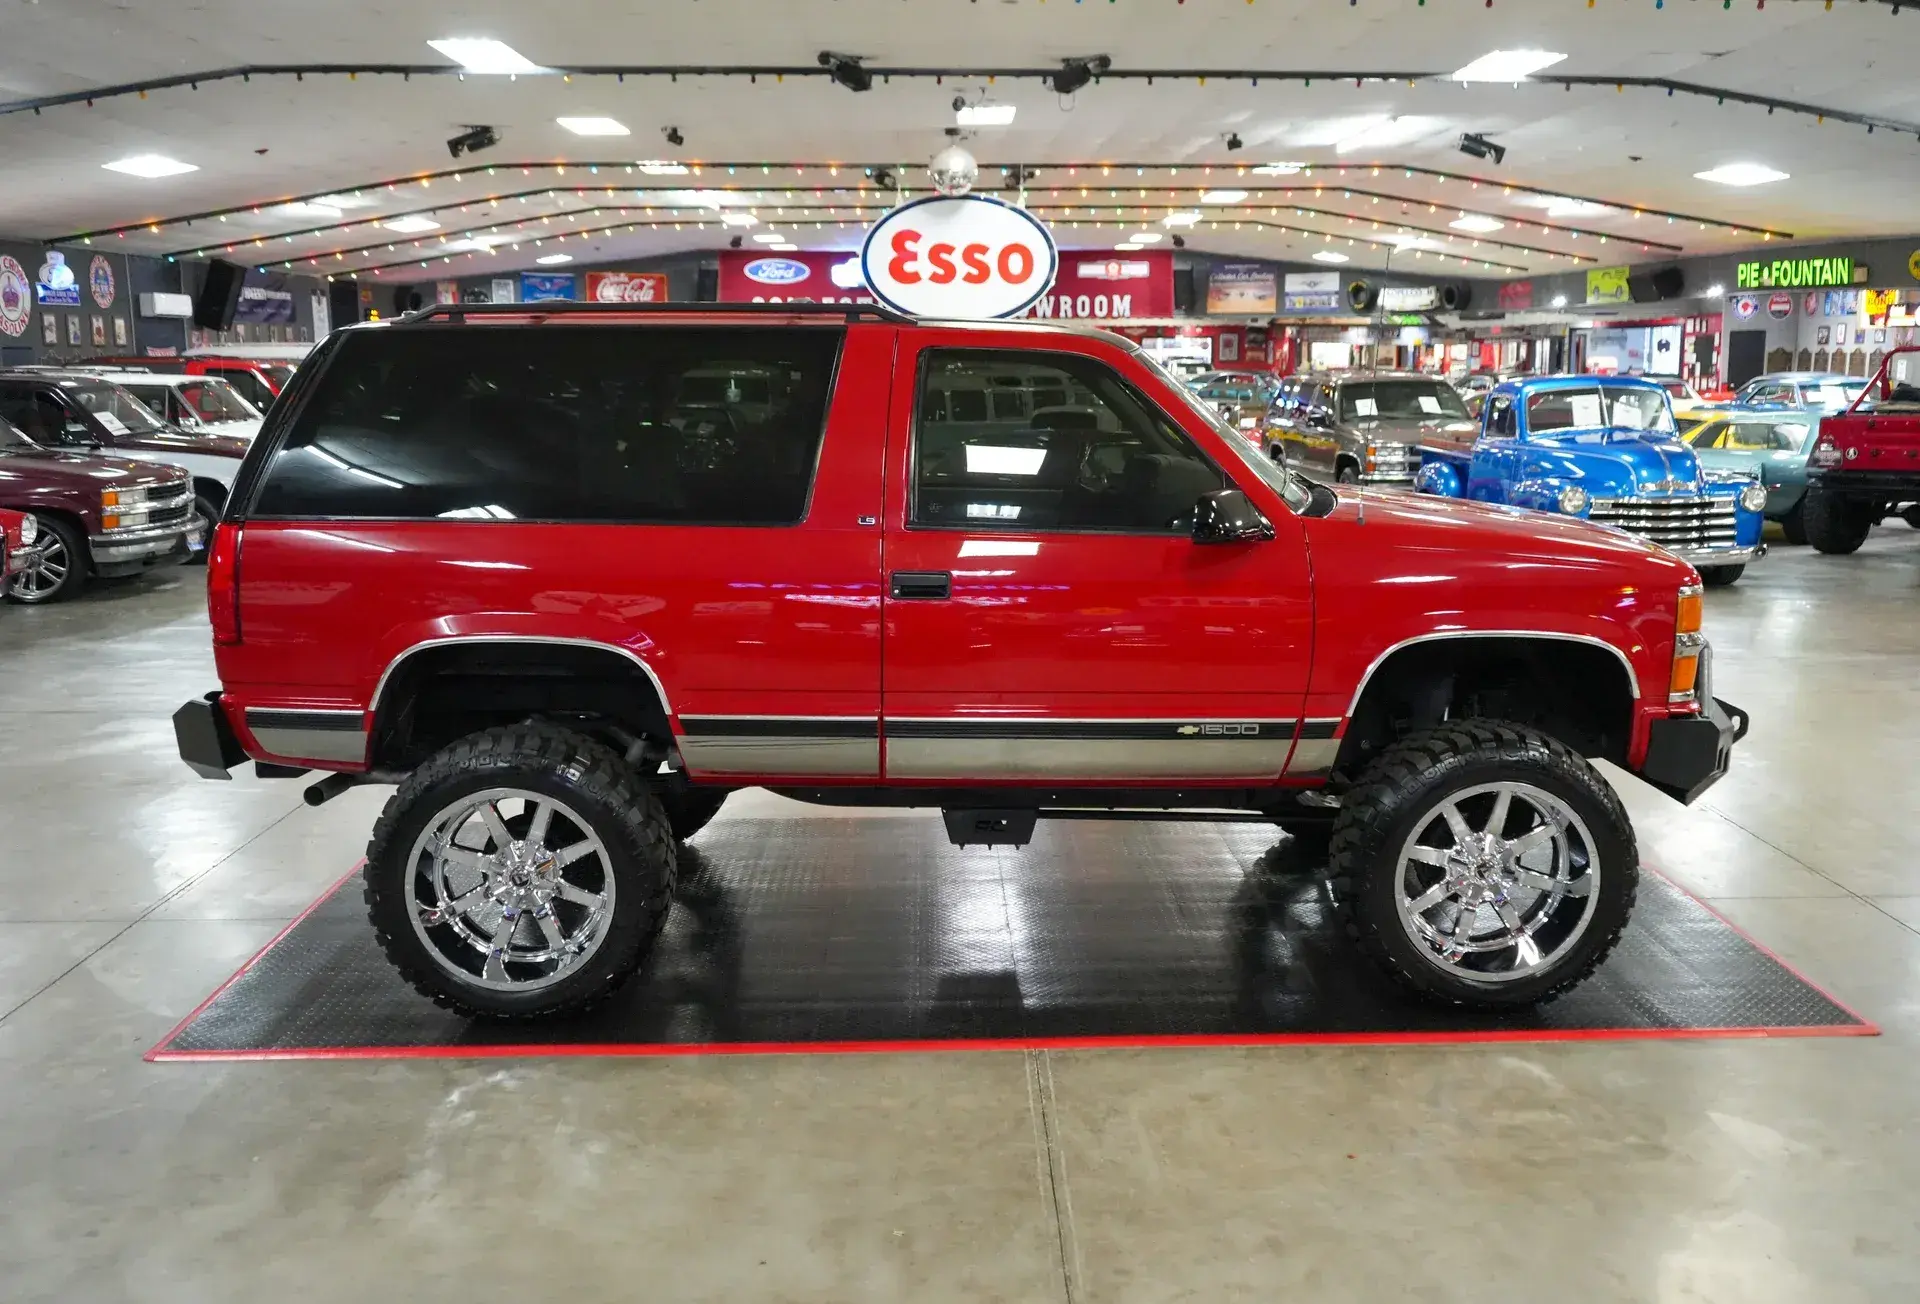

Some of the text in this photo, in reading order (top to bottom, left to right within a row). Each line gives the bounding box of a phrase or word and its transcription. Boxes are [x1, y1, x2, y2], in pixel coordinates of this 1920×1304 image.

[888, 229, 1034, 285] Esso
[758, 262, 796, 280] Ford
[1737, 257, 1850, 288] PIE FOUNTAIN
[1018, 294, 1132, 318] WROOM
[1200, 723, 1260, 736] 1500
